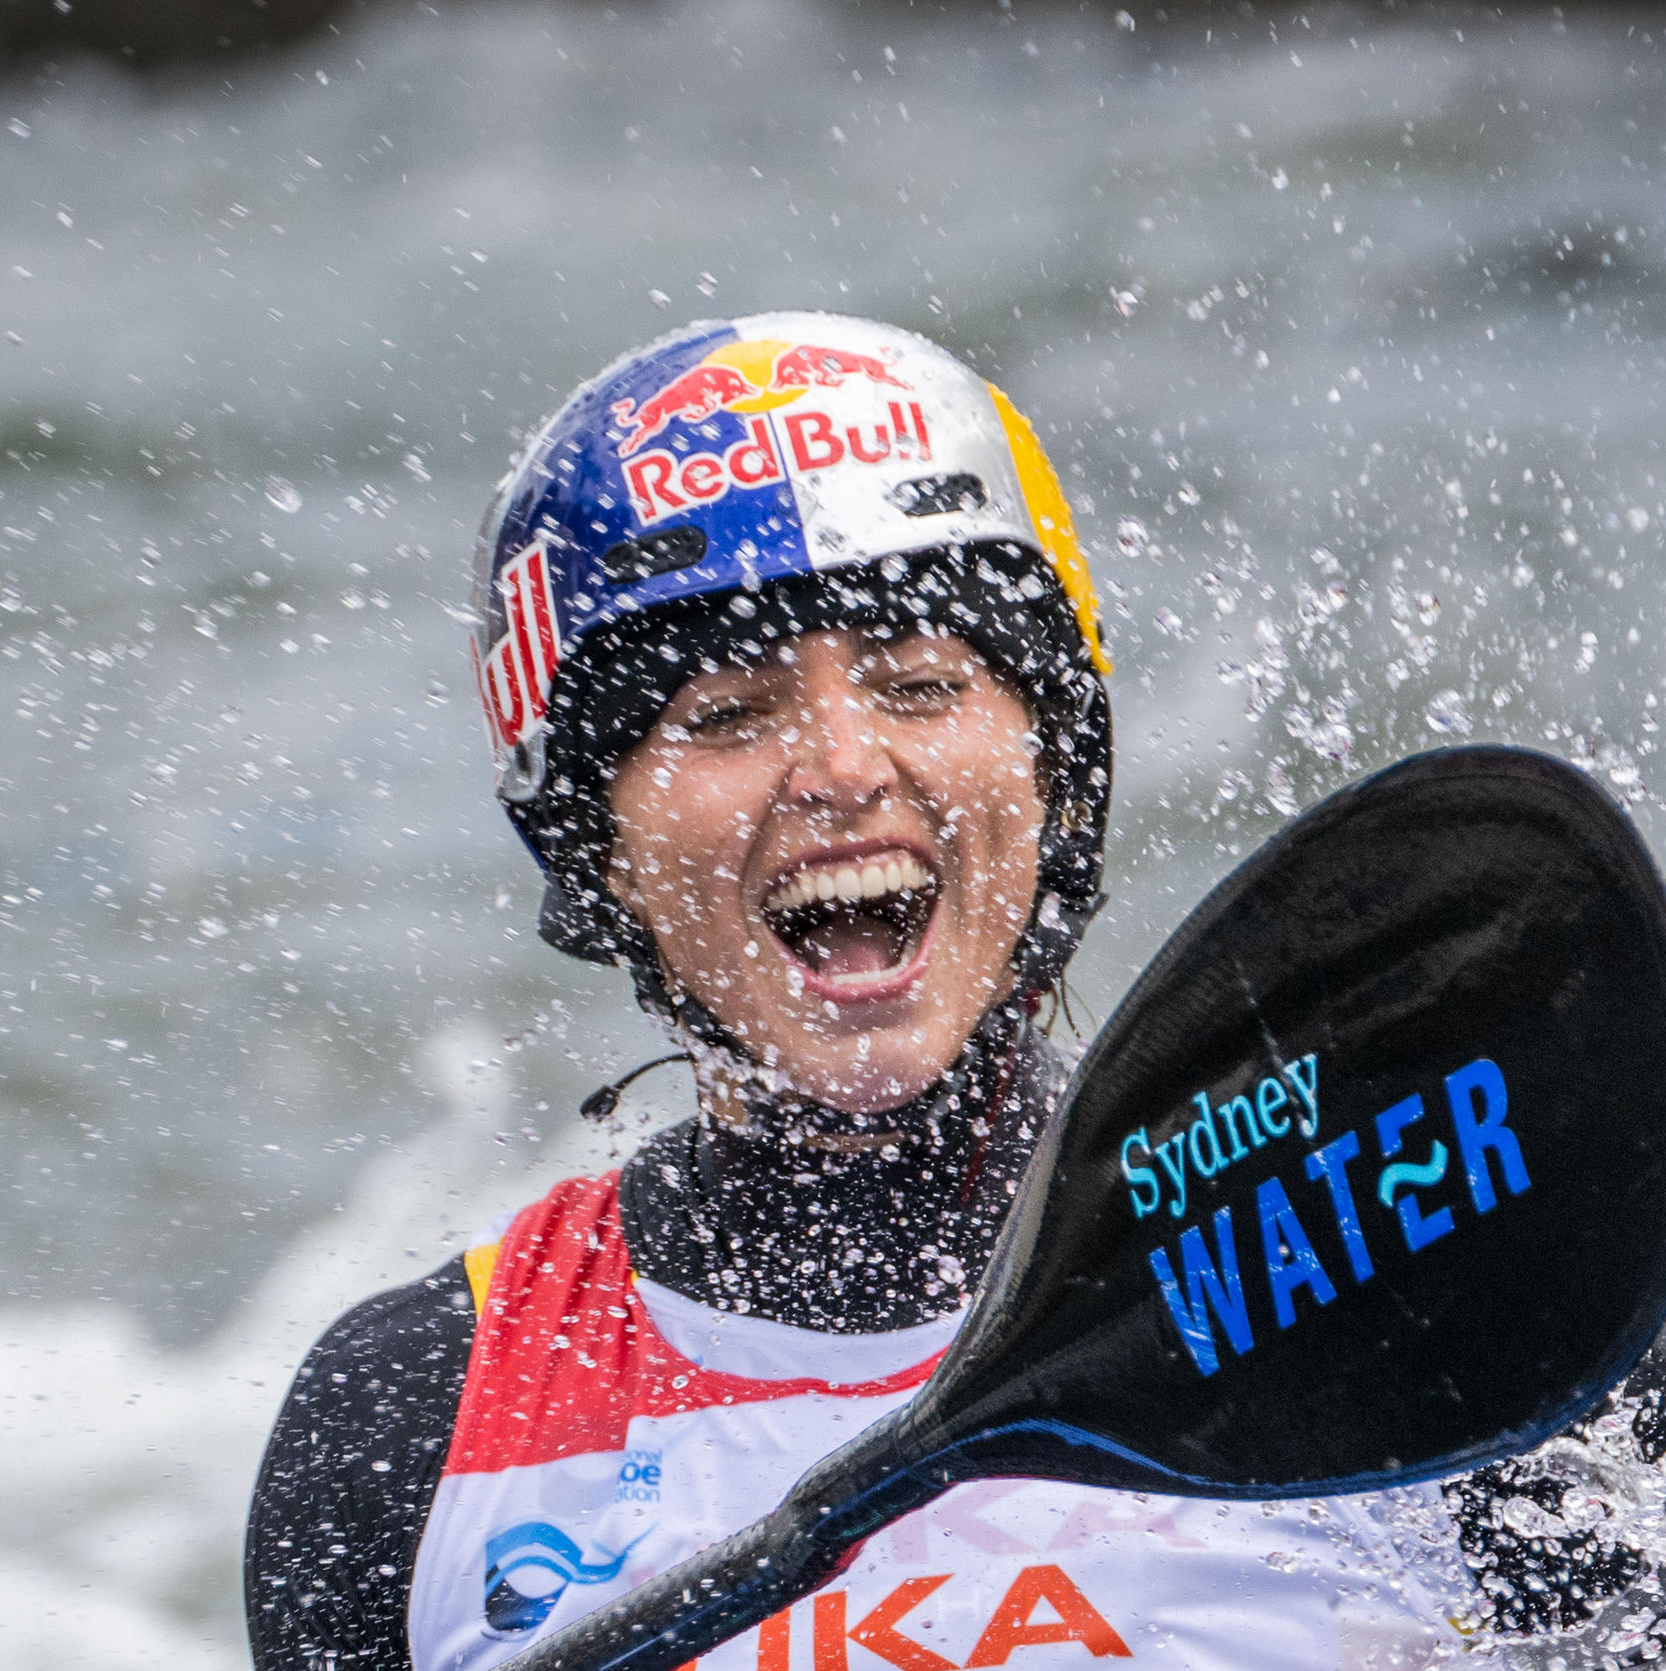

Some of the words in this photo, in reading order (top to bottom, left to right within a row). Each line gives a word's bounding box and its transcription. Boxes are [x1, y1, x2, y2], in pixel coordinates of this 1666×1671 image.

[628, 418, 780, 520] Red
[784, 402, 932, 472] Bull
[470, 551, 560, 760] ull
[1119, 1053, 1319, 1219] Sydney
[1147, 1058, 1532, 1378] WATER
